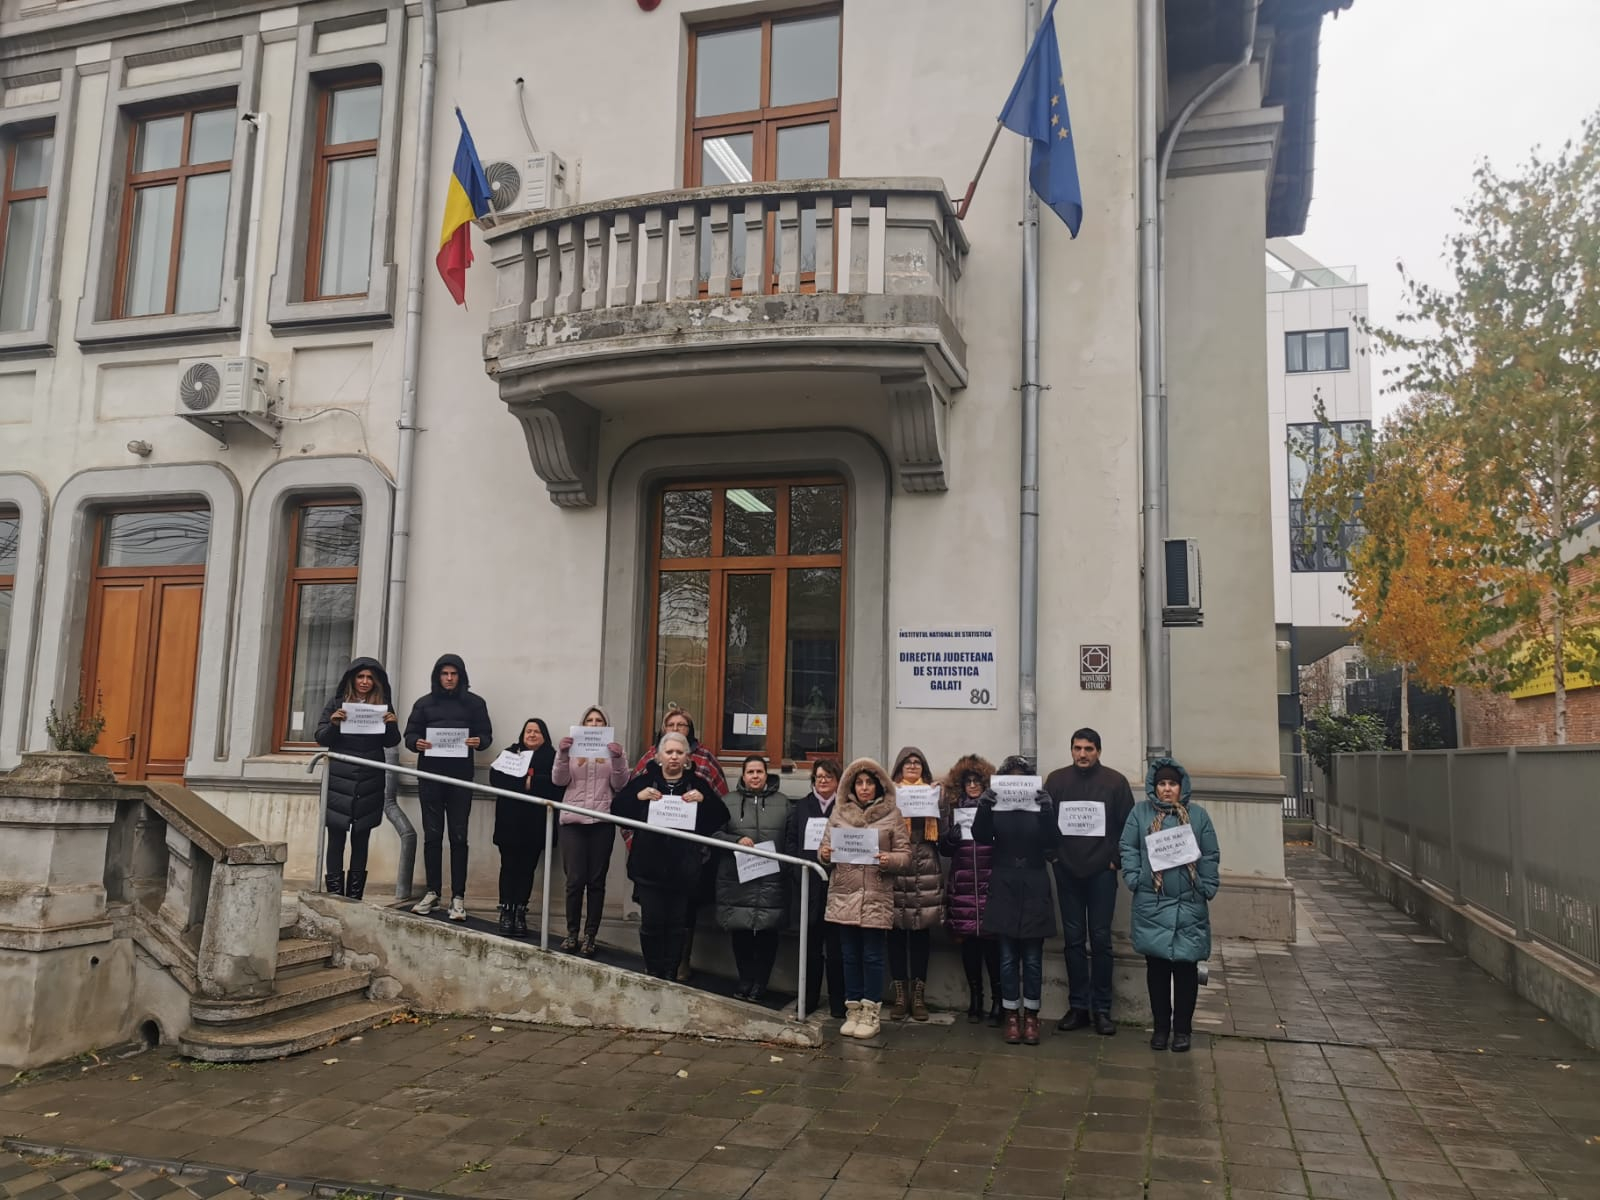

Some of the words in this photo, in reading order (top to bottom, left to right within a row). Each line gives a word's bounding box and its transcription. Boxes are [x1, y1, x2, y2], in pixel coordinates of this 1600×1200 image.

[900, 652, 941, 662] DIRECTIA
[943, 652, 994, 662] JUDETEANA
[914, 666, 924, 676] DE
[926, 666, 979, 676] STATISTICA
[930, 680, 962, 690] GALATI
[970, 688, 990, 704] 80
